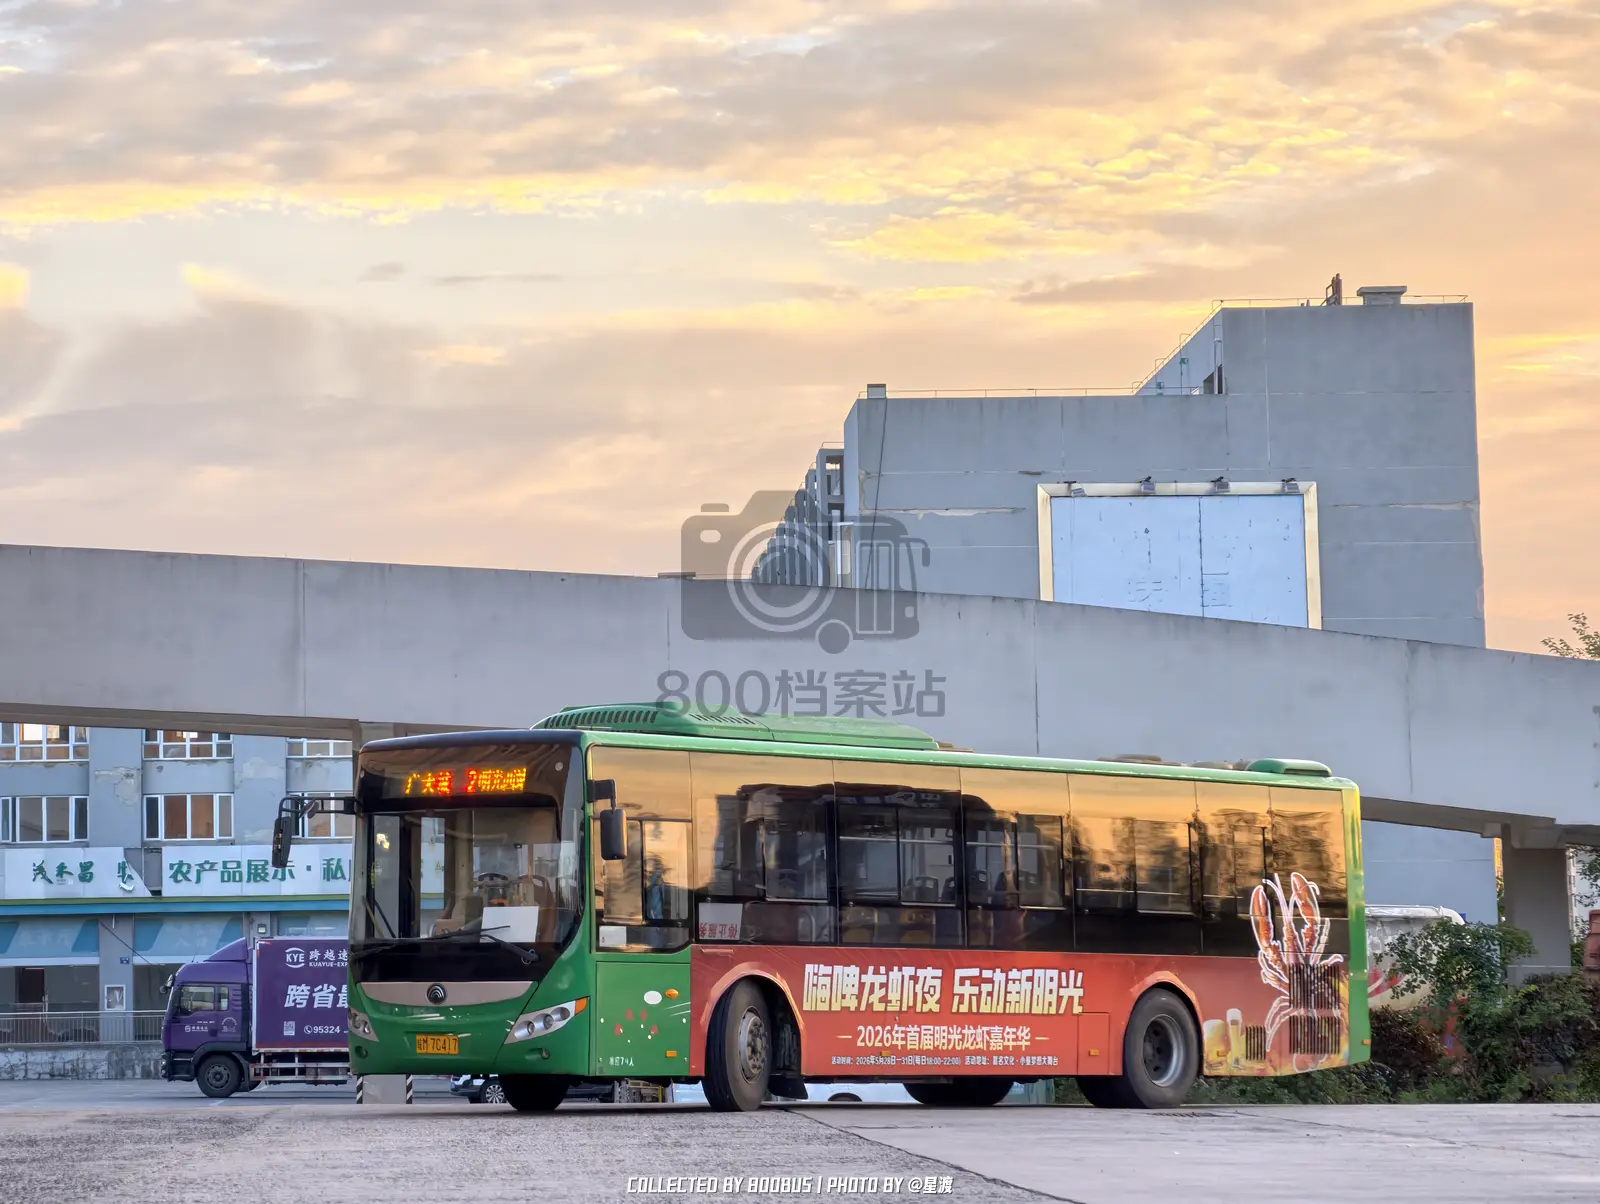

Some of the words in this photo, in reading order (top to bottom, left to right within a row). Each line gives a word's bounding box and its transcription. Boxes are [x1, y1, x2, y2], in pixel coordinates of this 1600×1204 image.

[286, 953, 305, 963] KYE
[802, 963, 943, 1013] 嗨啤龙虾夜
[951, 967, 1085, 1015] 乐动新明光
[313, 1025, 341, 1034] 95324
[856, 1023, 1032, 1051] 2026年首届明光龙虾嘉年华
